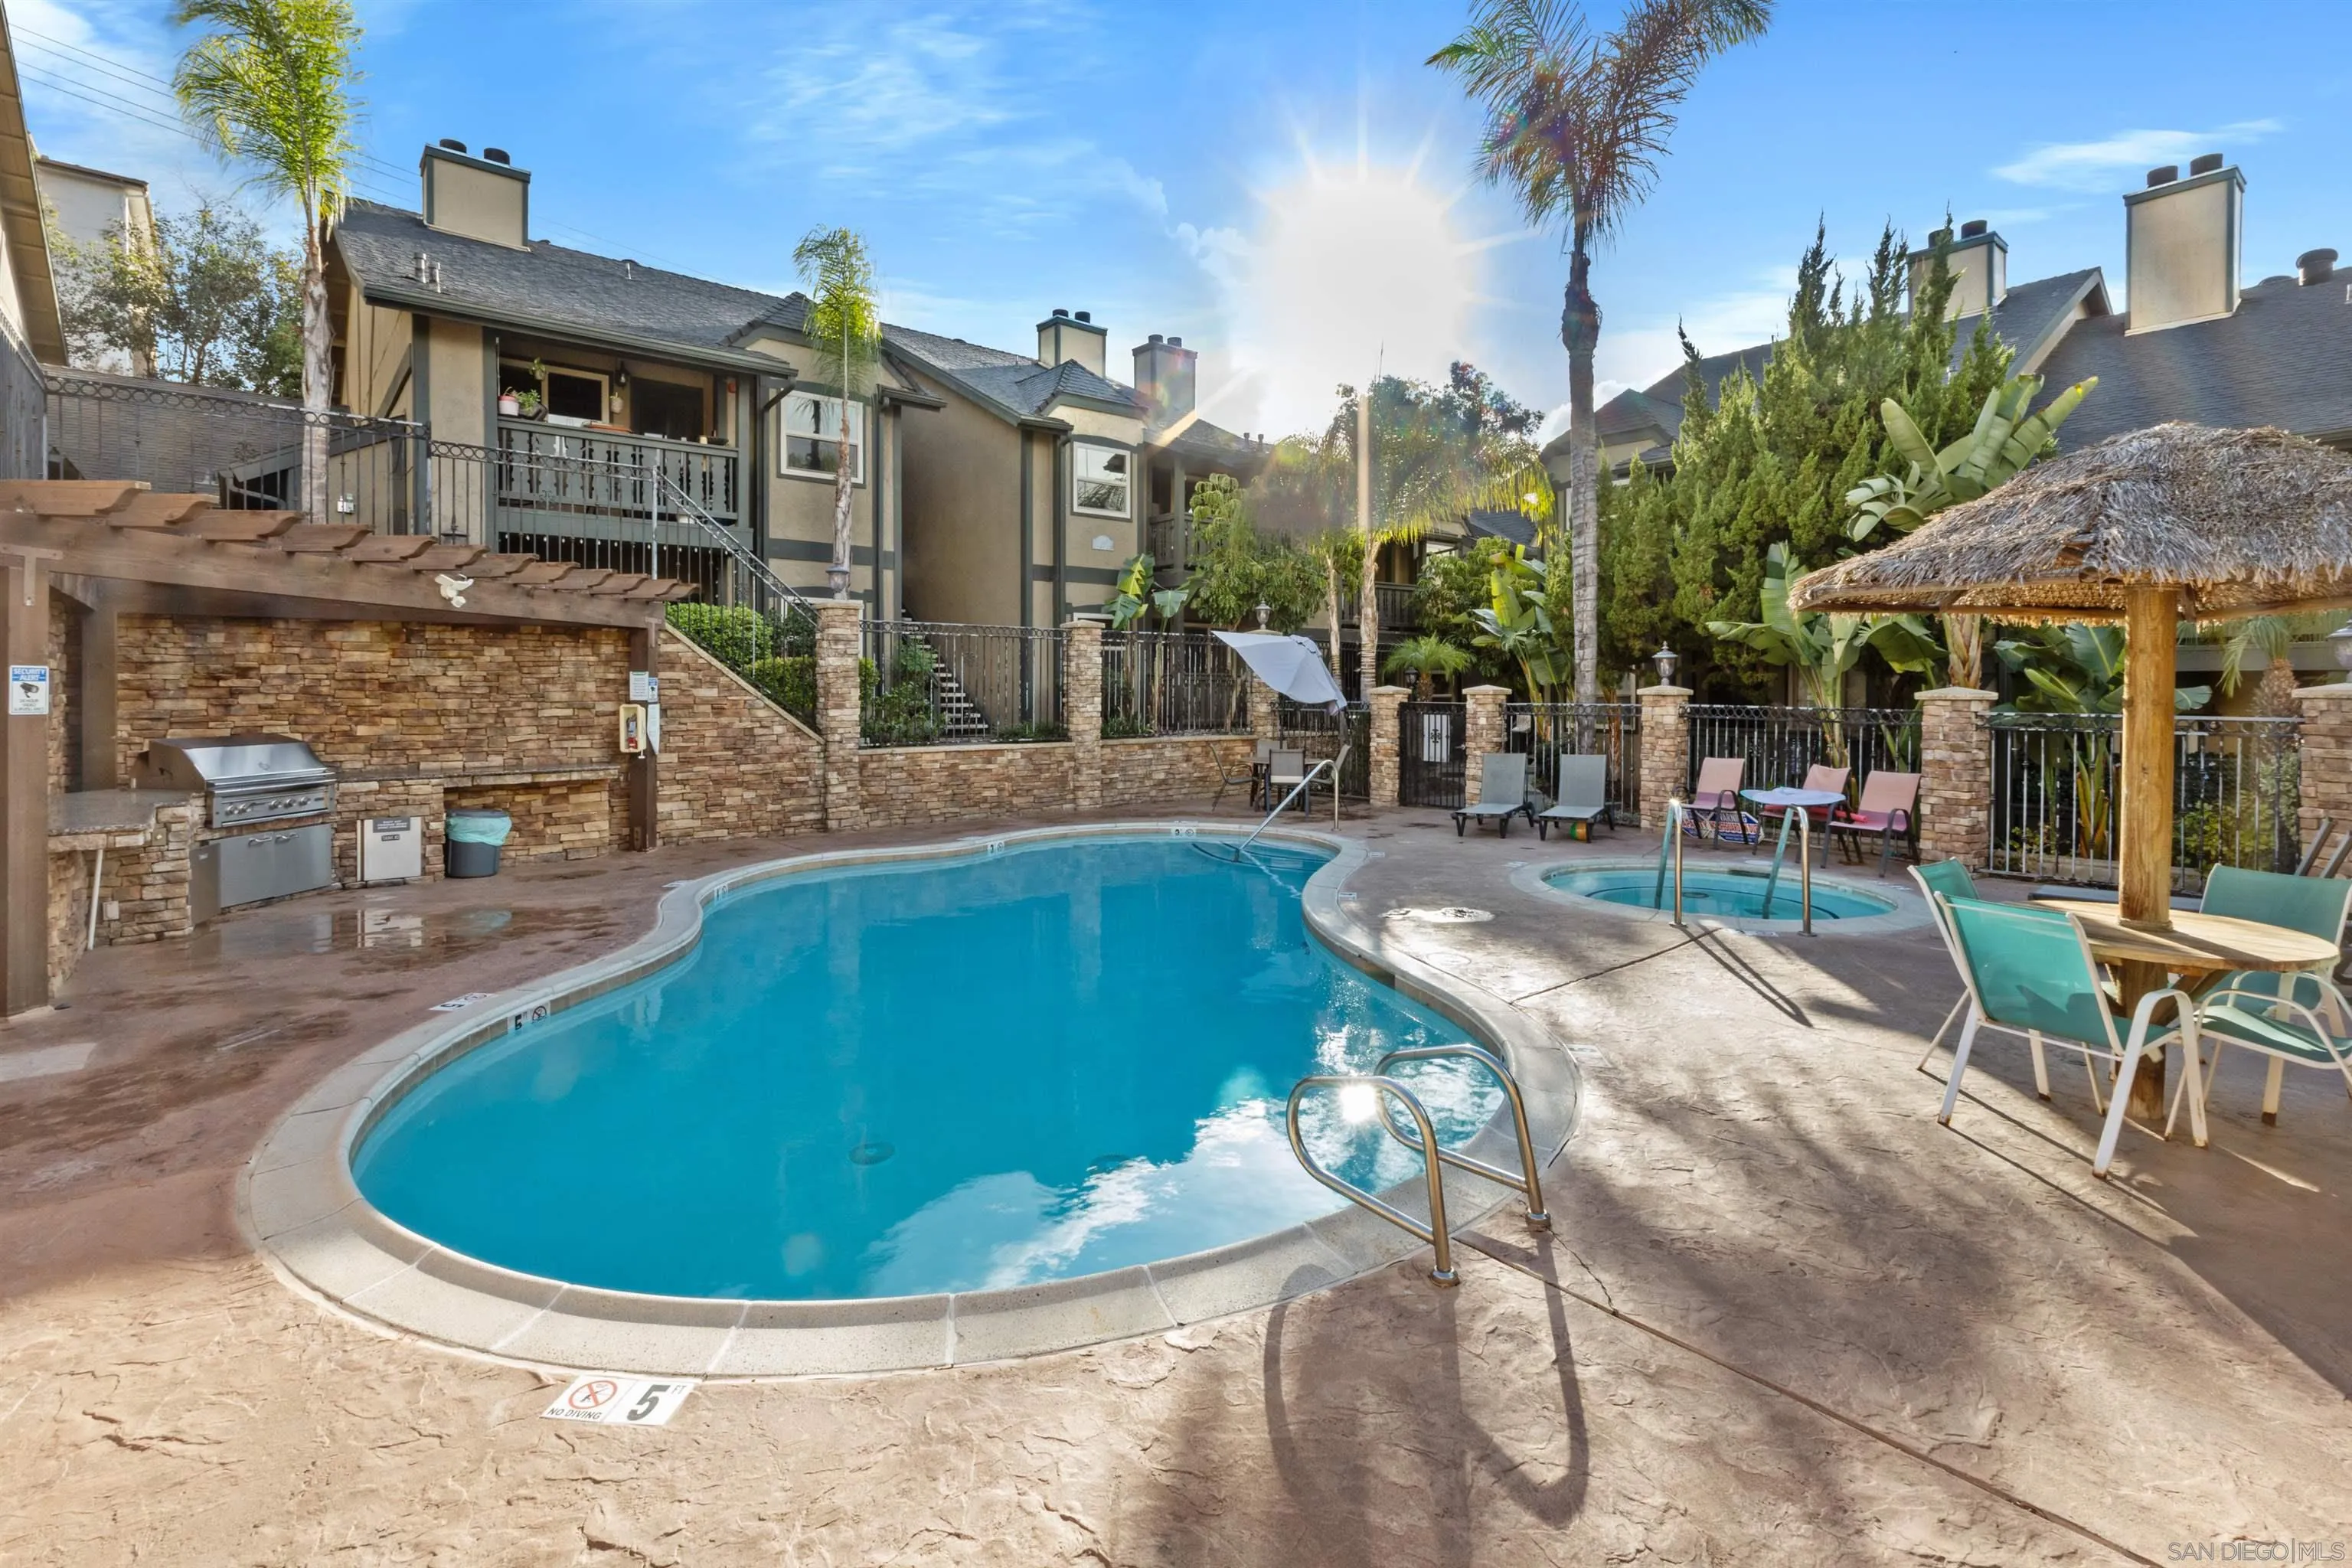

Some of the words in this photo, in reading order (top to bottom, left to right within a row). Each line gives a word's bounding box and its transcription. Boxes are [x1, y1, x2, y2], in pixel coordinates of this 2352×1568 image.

[547, 1407, 565, 1416] NO
[564, 1410, 603, 1419] DIVING
[626, 1384, 671, 1421] 5
[671, 1385, 687, 1394] FT
